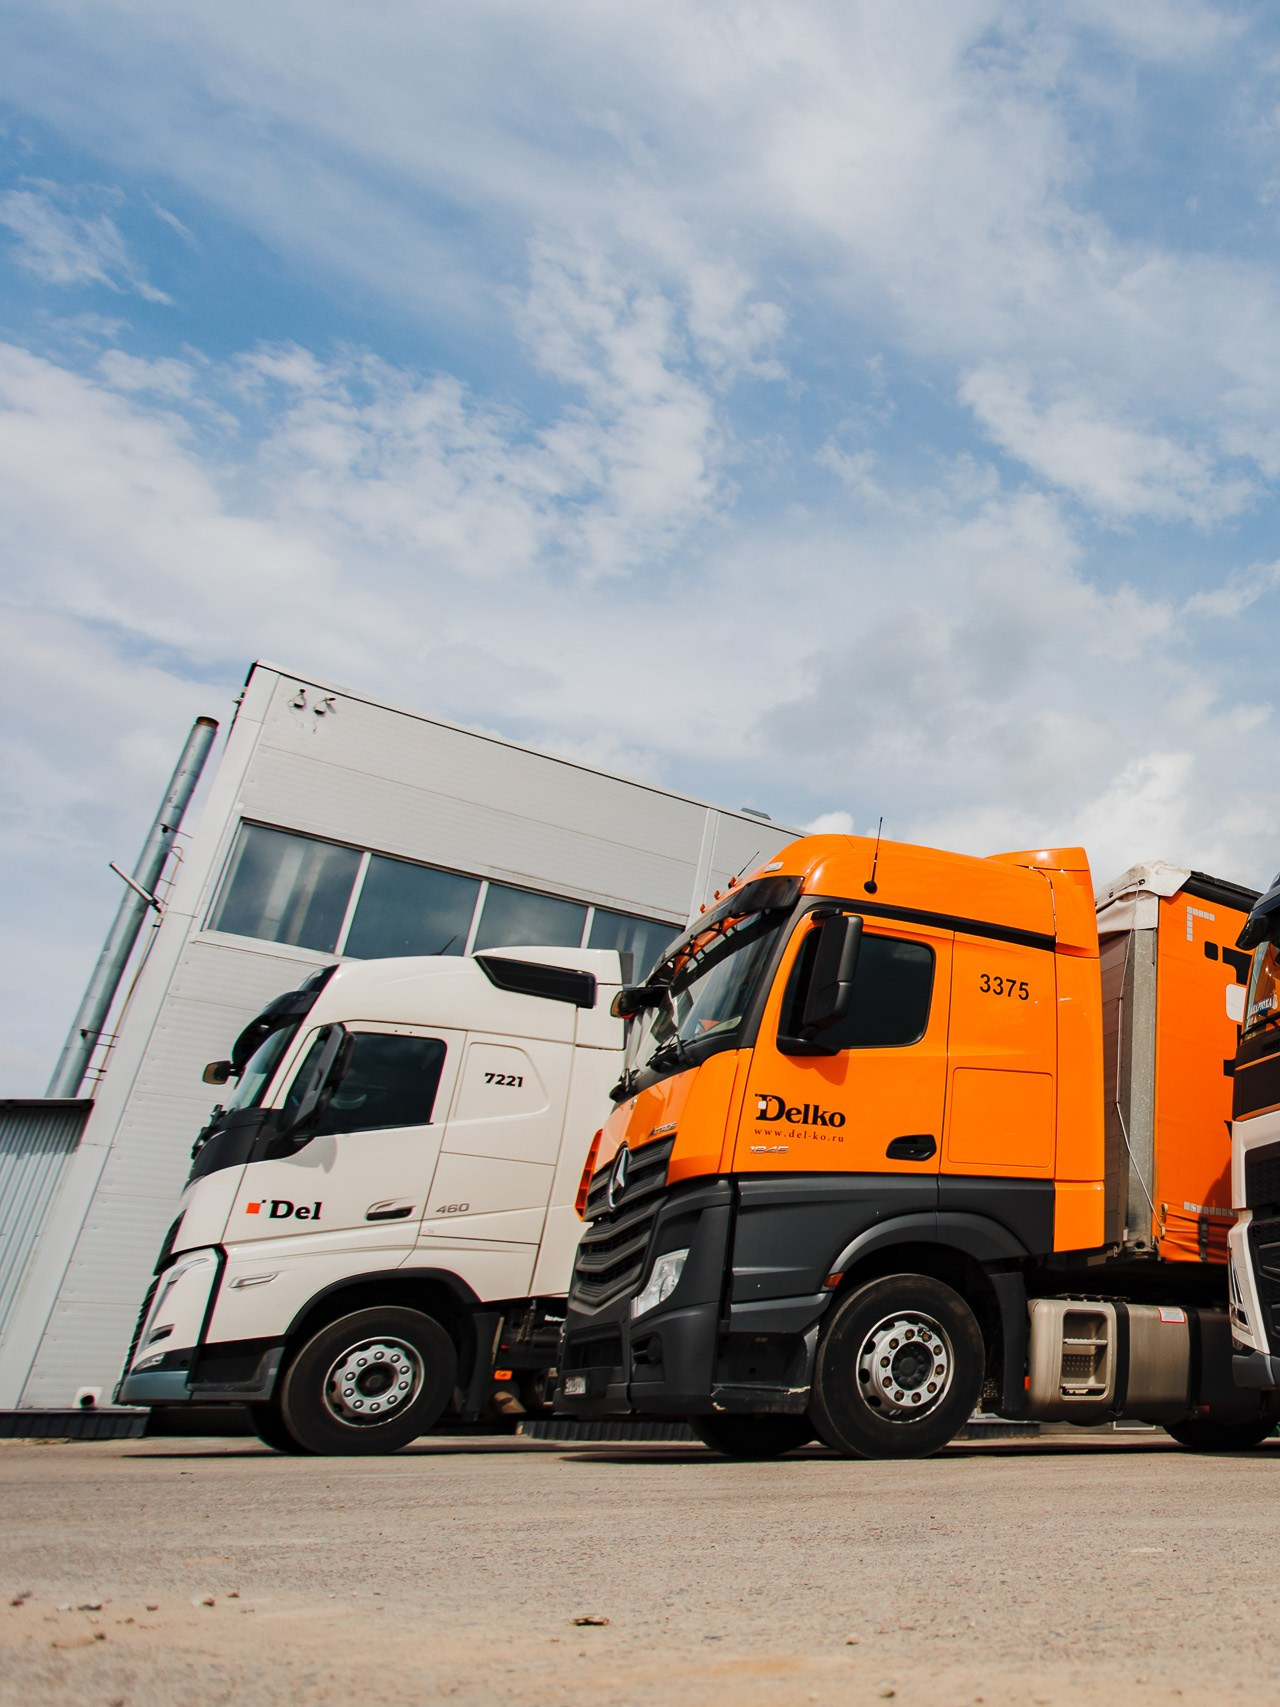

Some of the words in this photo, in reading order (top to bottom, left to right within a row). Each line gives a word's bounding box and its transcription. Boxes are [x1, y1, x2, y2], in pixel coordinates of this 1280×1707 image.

[980, 973, 1029, 1001] 3375
[484, 1072, 524, 1088] 7221
[755, 1093, 847, 1128] Delko
[754, 1128, 845, 1143] www.del-ko.ru
[749, 1145, 790, 1155] 1845
[268, 1199, 323, 1220] Del
[435, 1203, 470, 1214] 460
